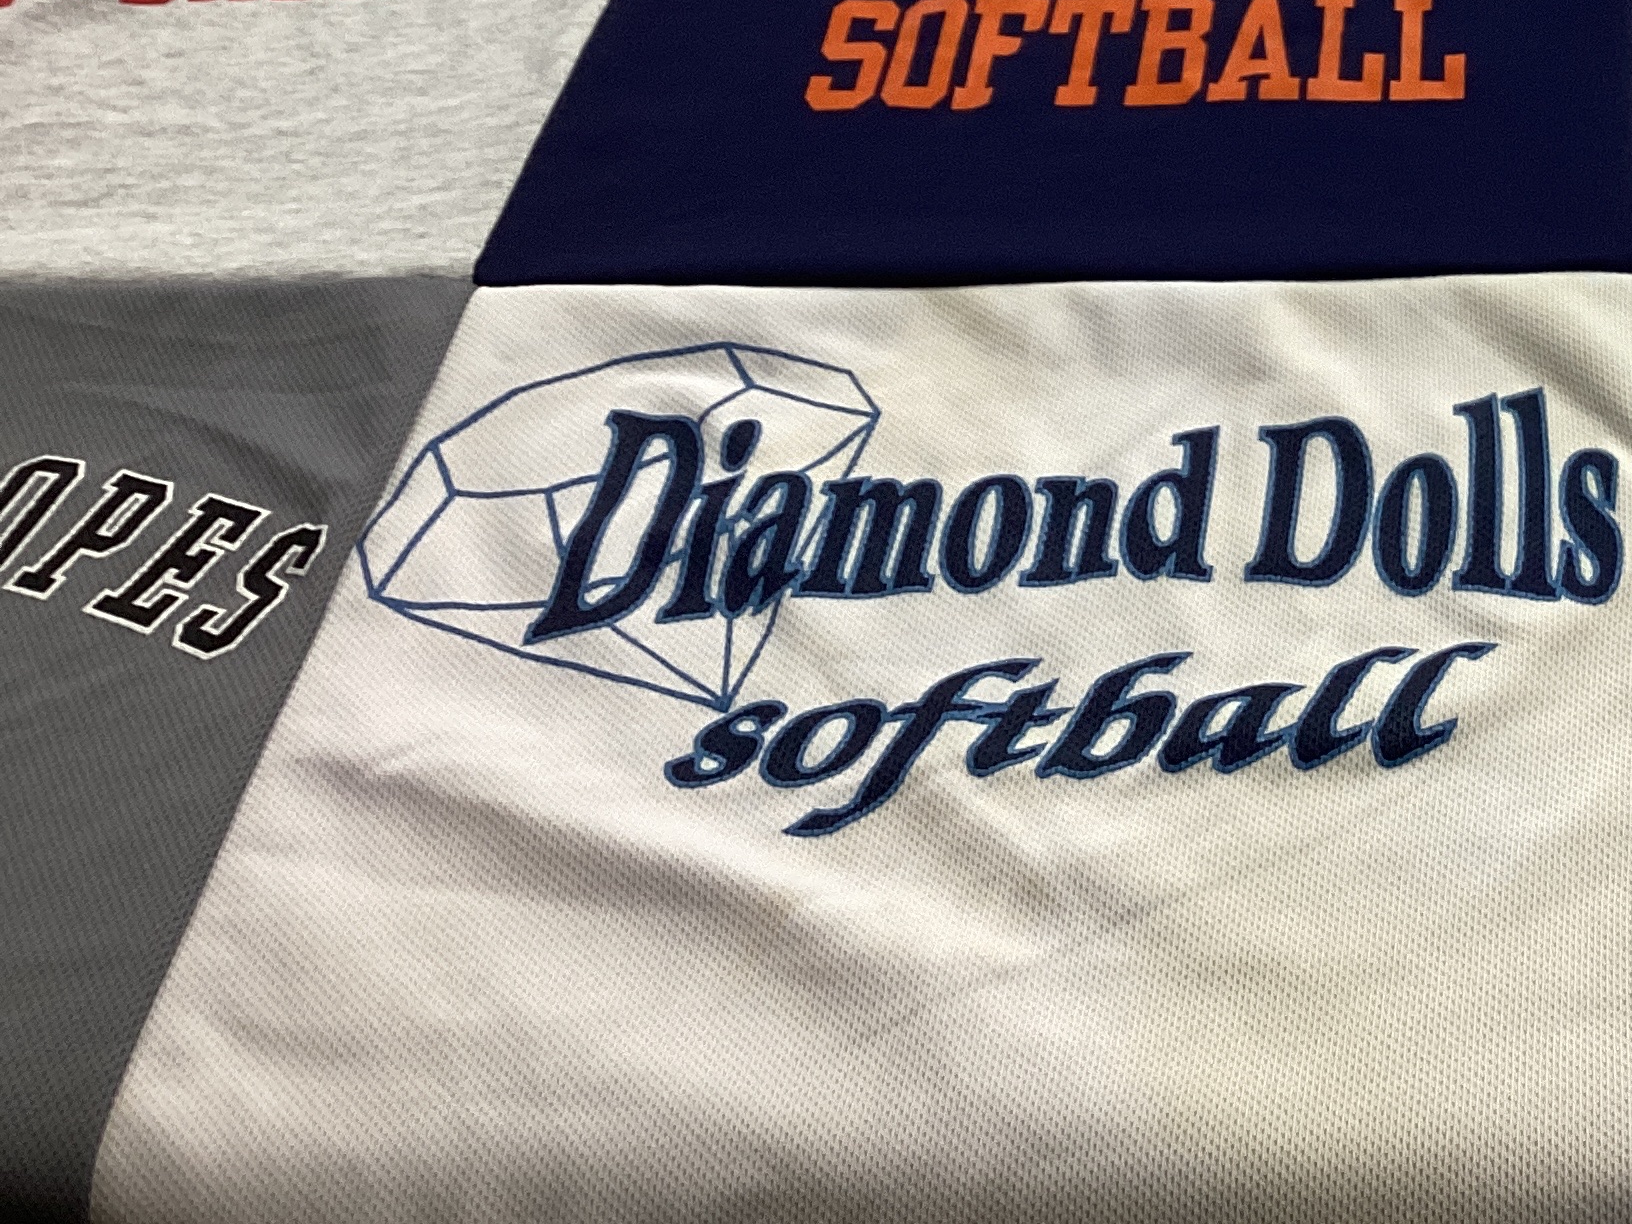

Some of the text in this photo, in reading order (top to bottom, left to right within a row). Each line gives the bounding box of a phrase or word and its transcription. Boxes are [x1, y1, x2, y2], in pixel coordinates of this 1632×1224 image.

[522, 385, 1624, 645] Diamond Dolls
[663, 641, 1500, 837] softball
